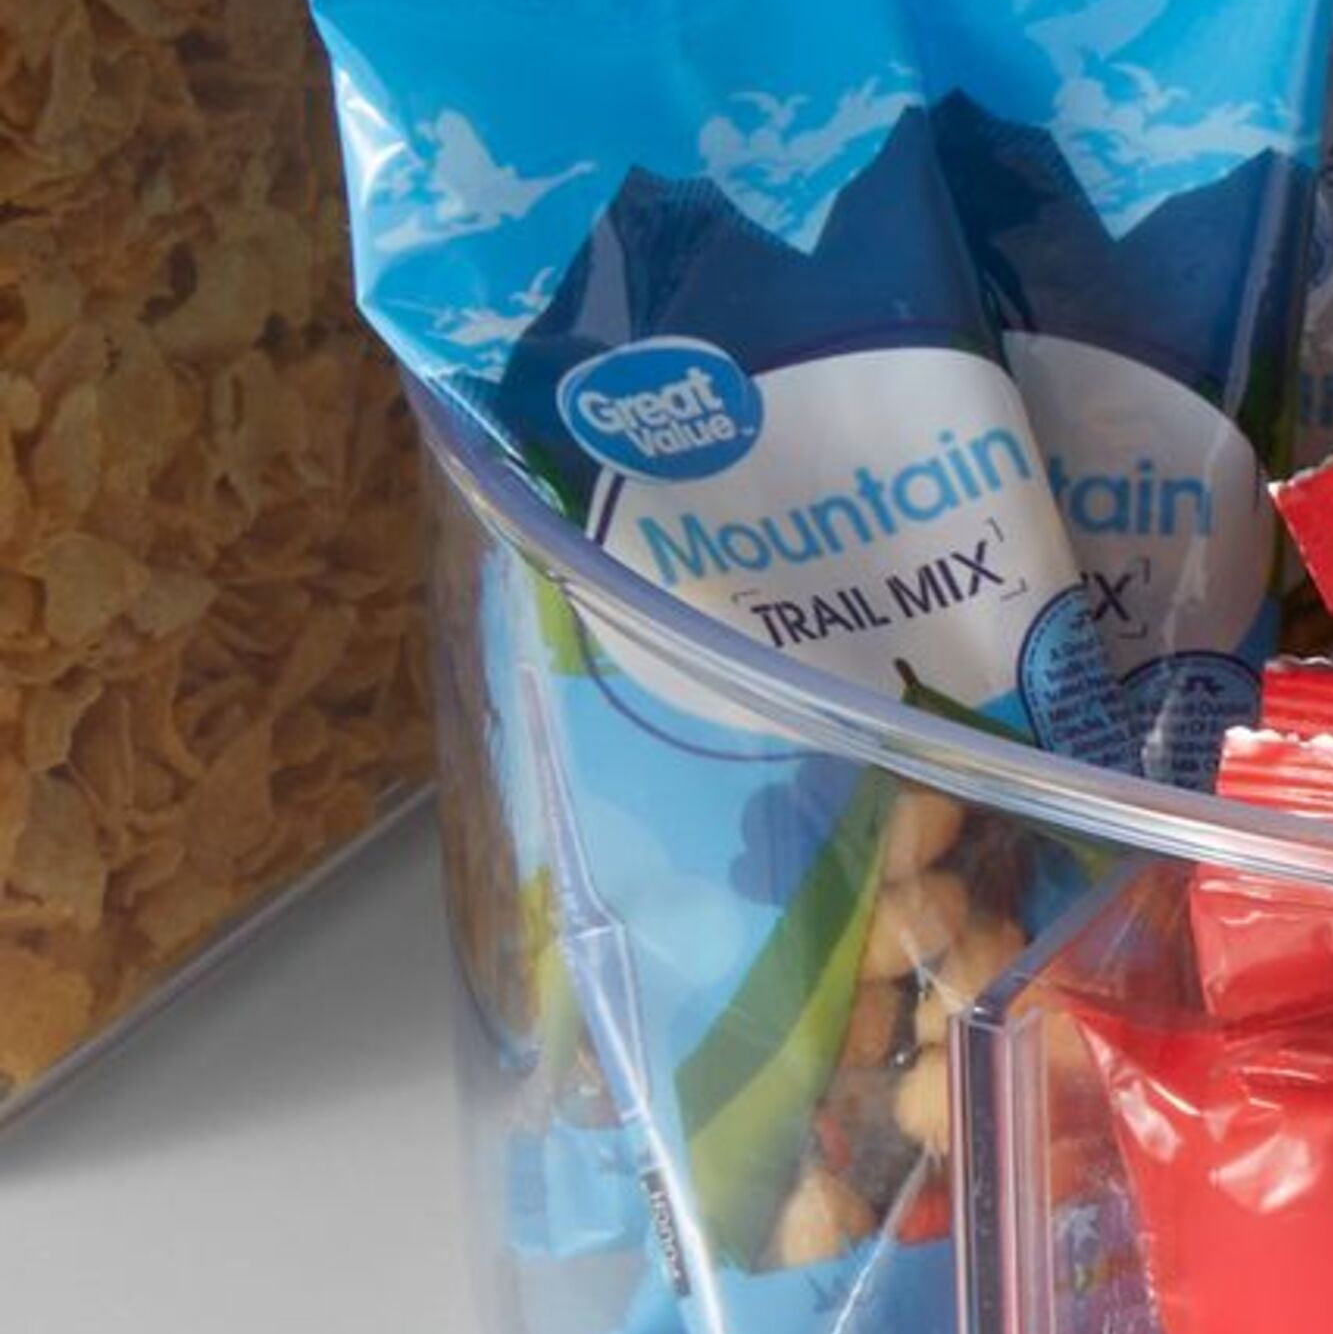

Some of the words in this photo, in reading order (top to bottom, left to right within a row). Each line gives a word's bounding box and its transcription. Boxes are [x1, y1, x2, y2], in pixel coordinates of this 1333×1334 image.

[576, 365, 725, 436] Great
[624, 411, 739, 459] Value
[636, 423, 1034, 588] Mountain
[750, 585, 890, 650] TRAIL
[886, 537, 1006, 619] MIX
